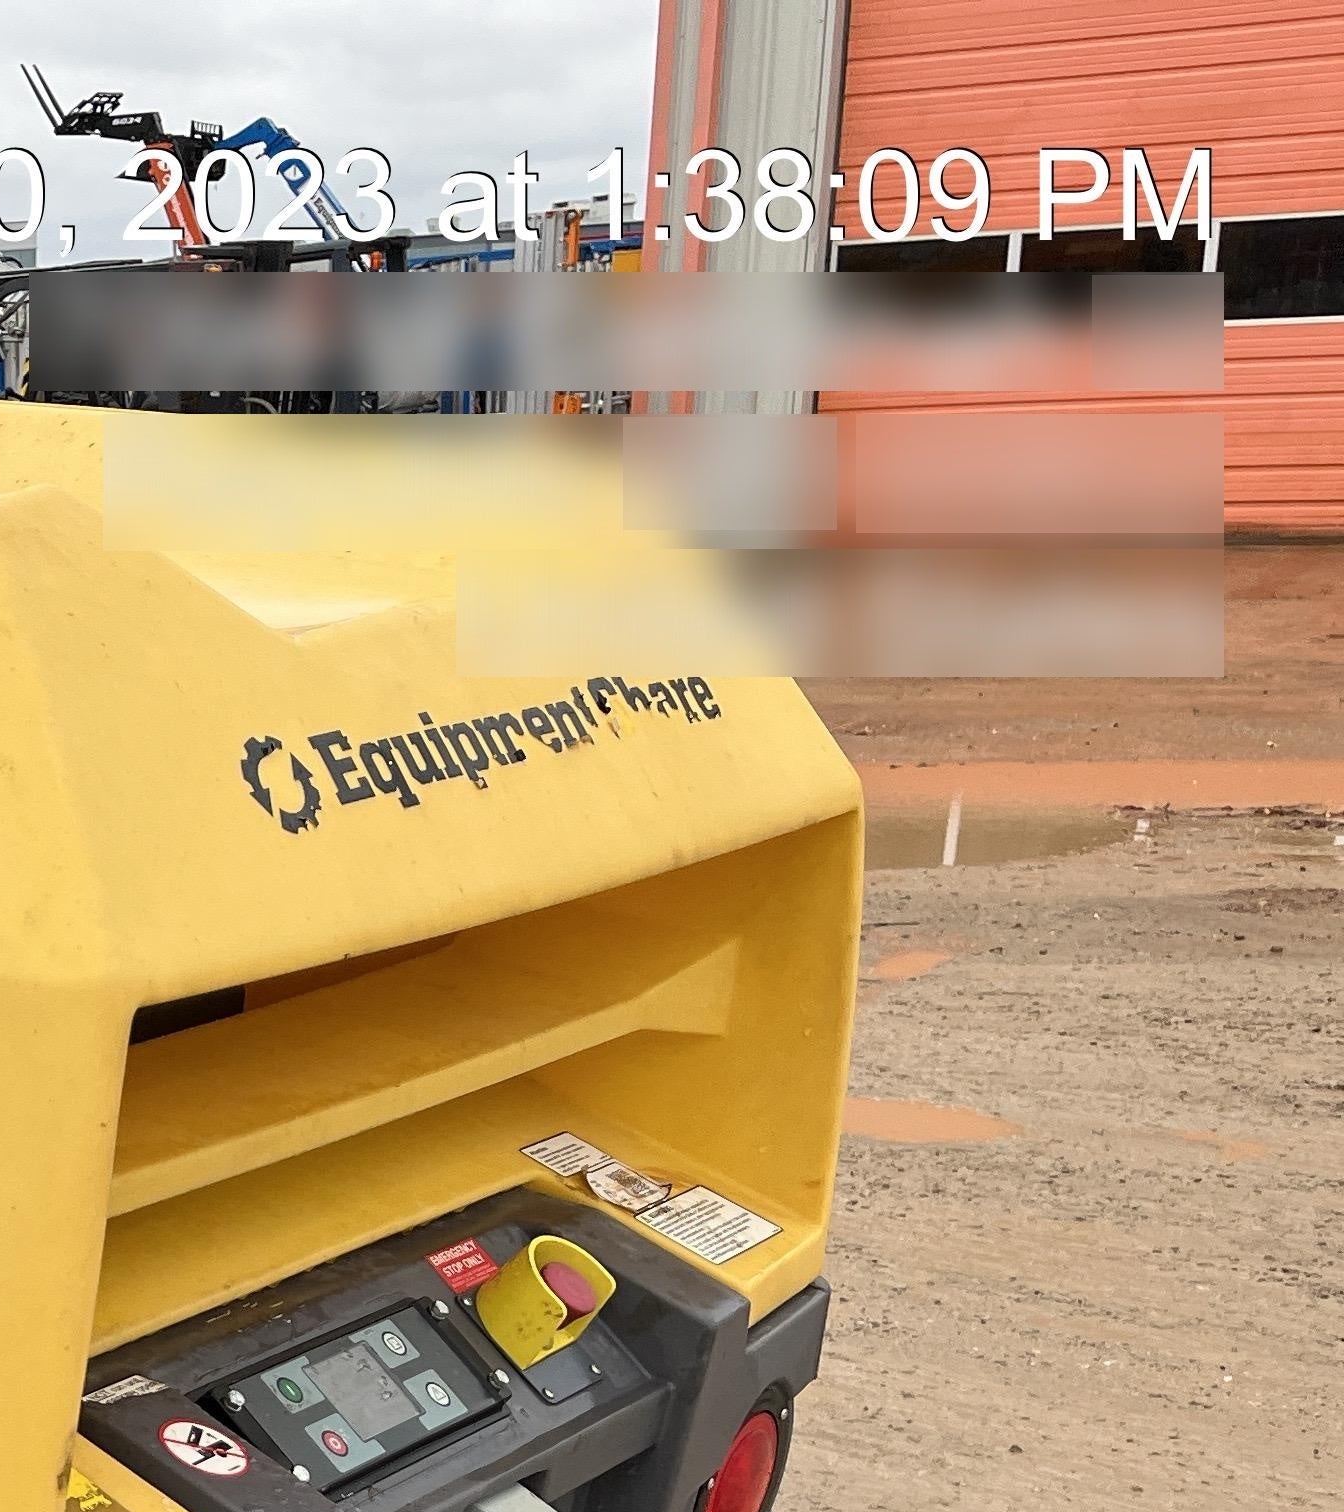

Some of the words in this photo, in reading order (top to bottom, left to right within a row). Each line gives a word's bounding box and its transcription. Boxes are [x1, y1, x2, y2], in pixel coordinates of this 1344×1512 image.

[429, 1239, 478, 1267] EMERGENCY
[442, 1261, 465, 1278] STOP
[461, 1252, 486, 1269] ONLY
